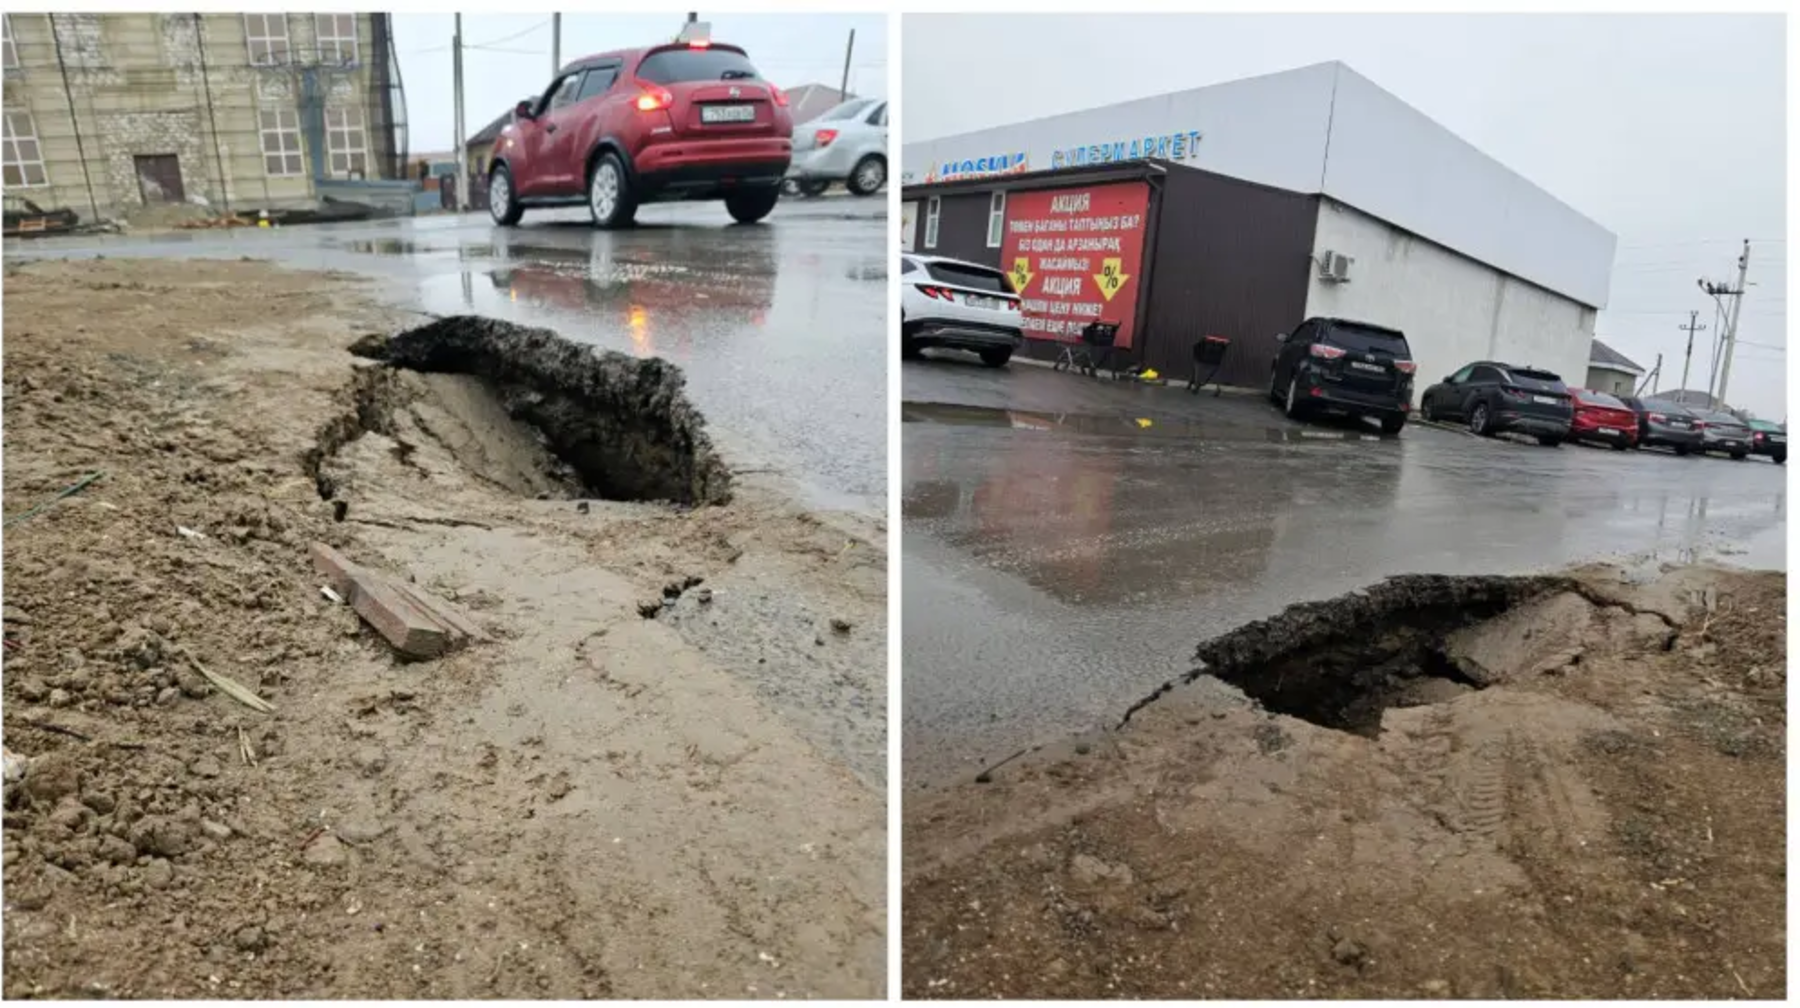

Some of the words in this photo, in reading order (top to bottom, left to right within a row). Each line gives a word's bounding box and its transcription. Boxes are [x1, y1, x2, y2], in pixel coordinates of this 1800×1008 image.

[1051, 131, 1203, 171] СУПЕРМАРКЕТ
[1050, 193, 1091, 214] АКЦИЯ
[1041, 276, 1082, 297] АКЦИЯ
